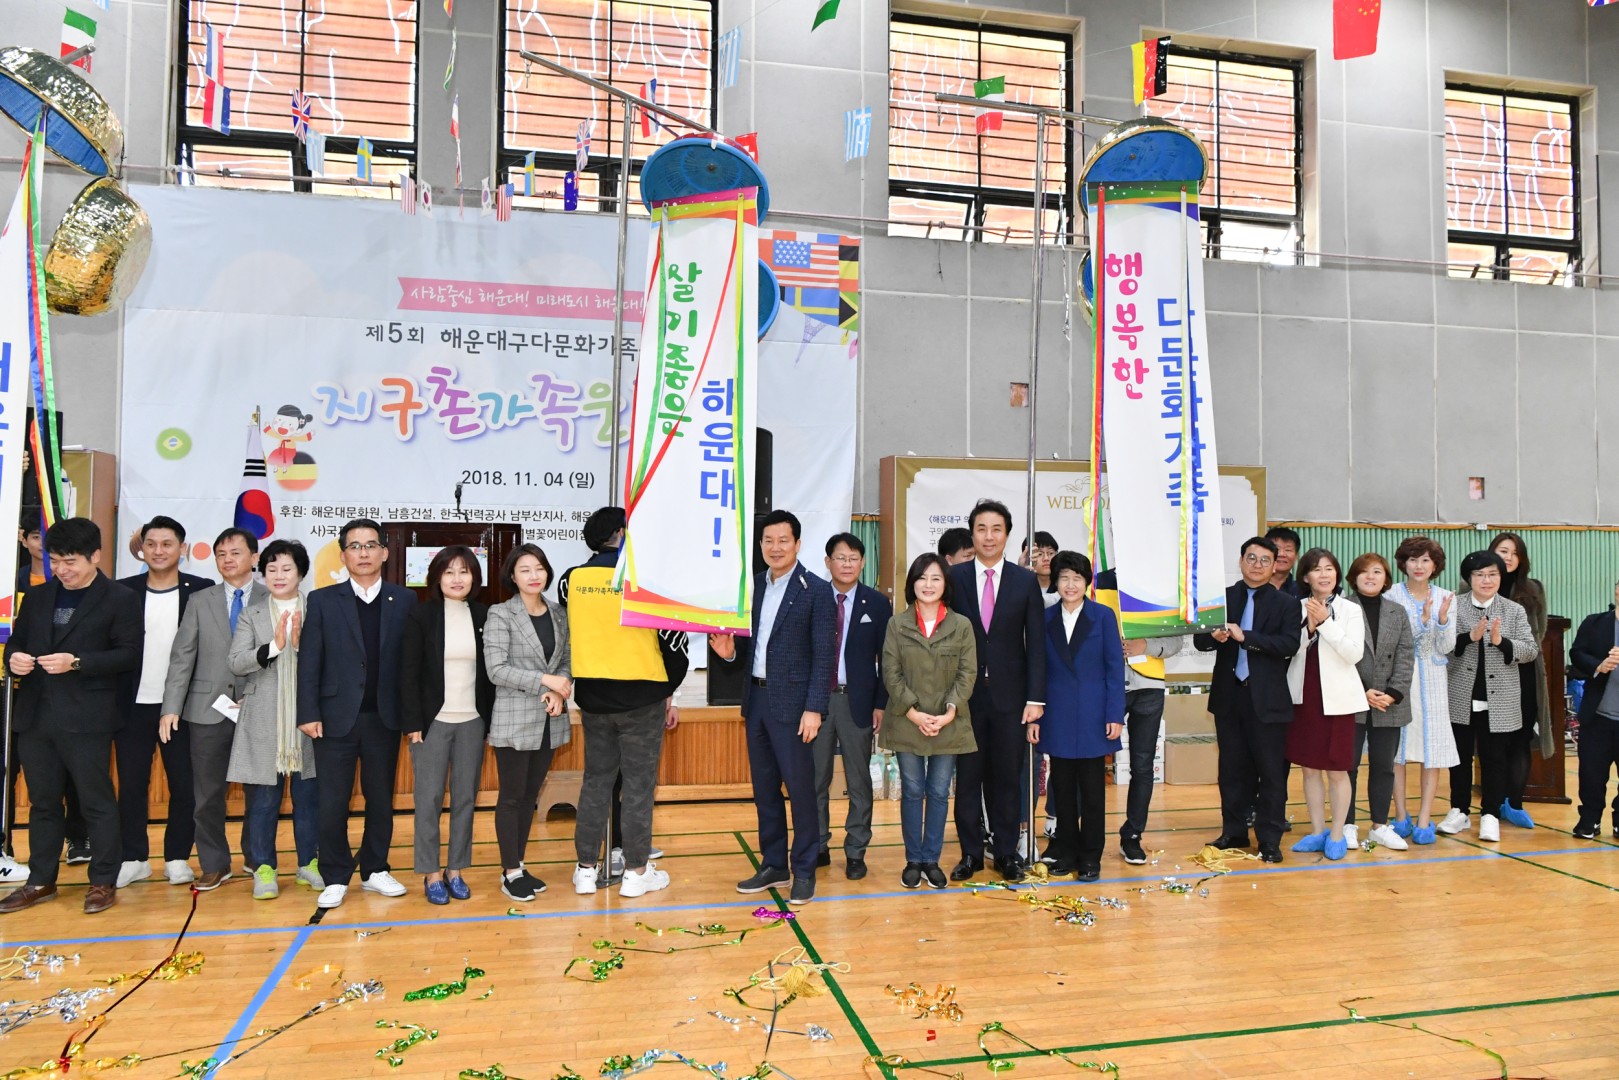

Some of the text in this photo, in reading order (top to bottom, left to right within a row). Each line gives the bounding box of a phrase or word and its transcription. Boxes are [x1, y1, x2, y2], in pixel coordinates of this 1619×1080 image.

[411, 284, 474, 308] 사람중심
[478, 288, 529, 306] 해운대!
[536, 294, 589, 308] 미래도시
[1105, 251, 1149, 400] 행복한
[365, 322, 641, 361] 제5회 해운대구다문화가족
[657, 262, 702, 438] 살기좋은
[316, 366, 638, 447] 지구촌가족운
[461, 469, 595, 489] 2018. 11. 04 (일)
[279, 505, 307, 518] 후원:
[311, 506, 384, 519] 해운대문화원,
[388, 507, 436, 520] 남흥건설,
[440, 508, 506, 521] 한국전력공사
[510, 510, 567, 522] 남부산지사,
[520, 528, 587, 541] 별꽃어린이
